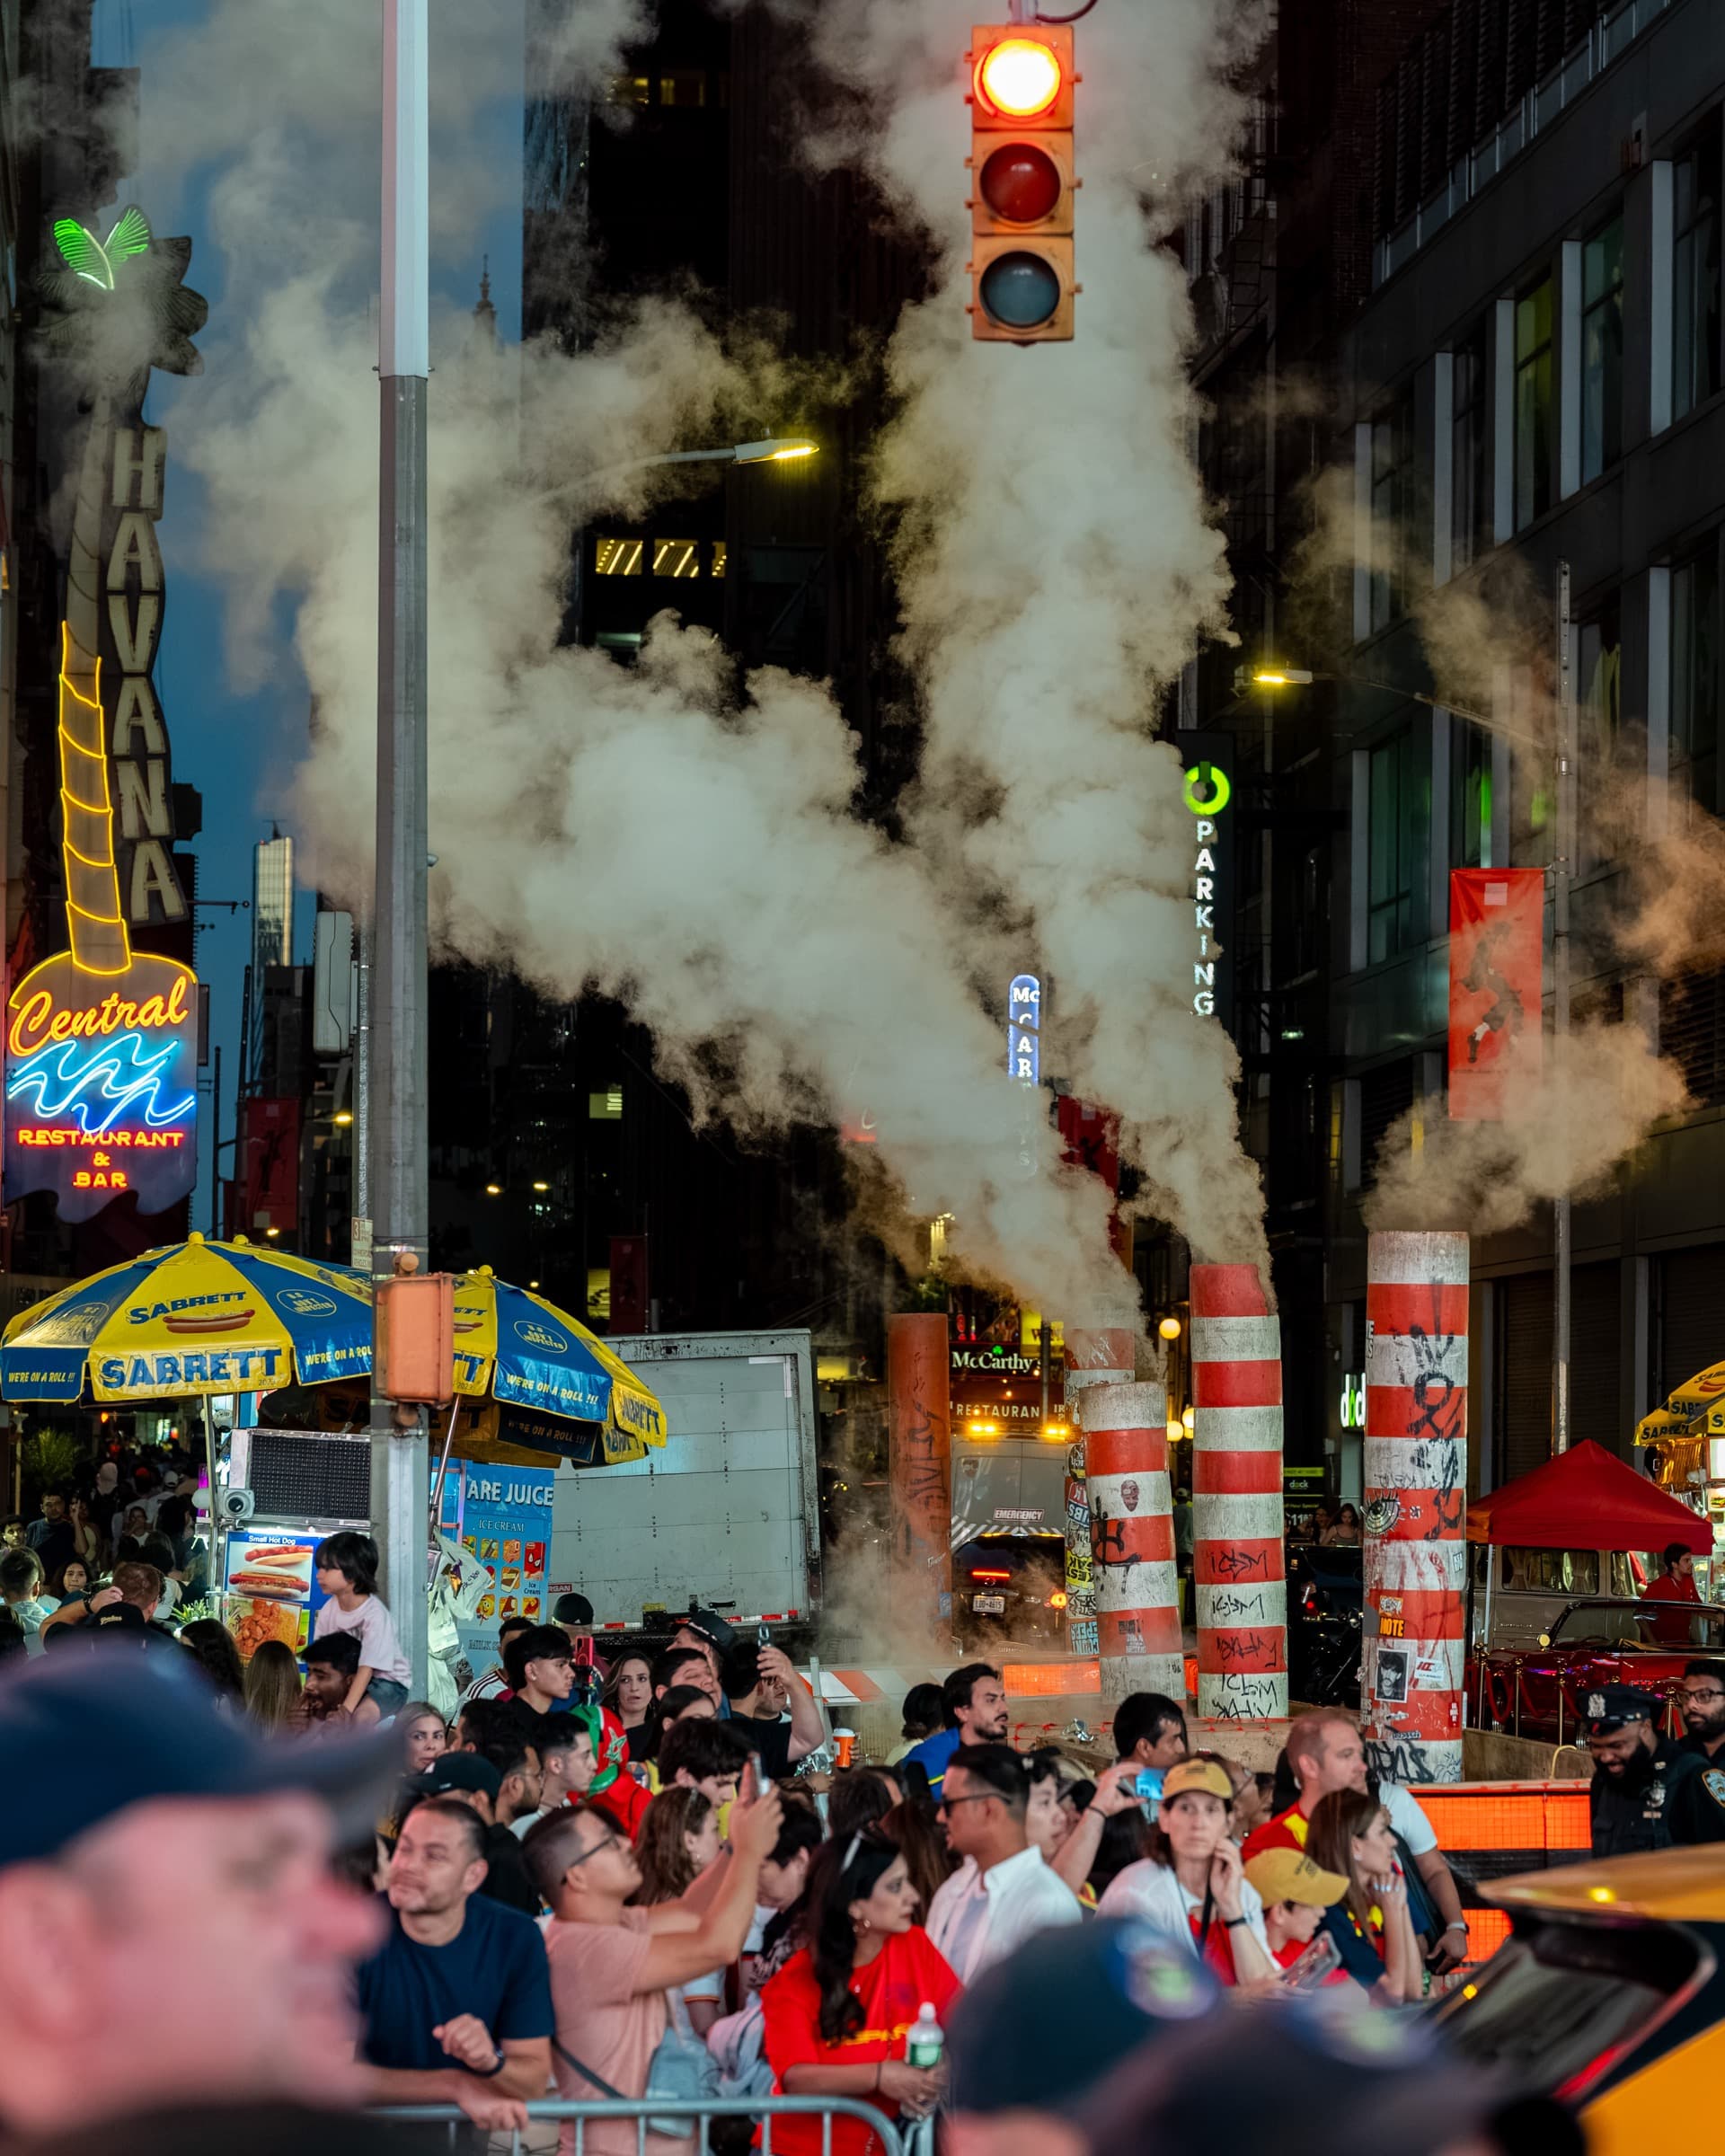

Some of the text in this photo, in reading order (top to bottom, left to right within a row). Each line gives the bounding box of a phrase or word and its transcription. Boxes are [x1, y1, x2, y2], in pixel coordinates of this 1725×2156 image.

[107, 427, 185, 921] HAVANA
[1193, 819, 1215, 1016] PARKING
[9, 975, 189, 1056] Central
[18, 1128, 184, 1147] RESTAURANT
[92, 1151, 111, 1168] &
[73, 1171, 128, 1188] BAR
[127, 1291, 247, 1325] SABRETT
[334, 1348, 347, 1361] ON
[349, 1348, 355, 1358] A
[8, 1372, 30, 1383] WE'RE
[30, 1372, 40, 1383] ON
[41, 1372, 48, 1383] A
[49, 1372, 66, 1383] ROLL
[100, 1347, 283, 1390] SABRETT
[536, 1382, 550, 1393] ON
[551, 1385, 559, 1396] A
[560, 1388, 583, 1402] ROLL
[466, 1479, 554, 1507] ARE JUICE
[995, 1509, 1043, 1520] EMERGENCY
[494, 1520, 525, 1533] CREAM
[248, 1534, 296, 1545] Small Hot Dog
